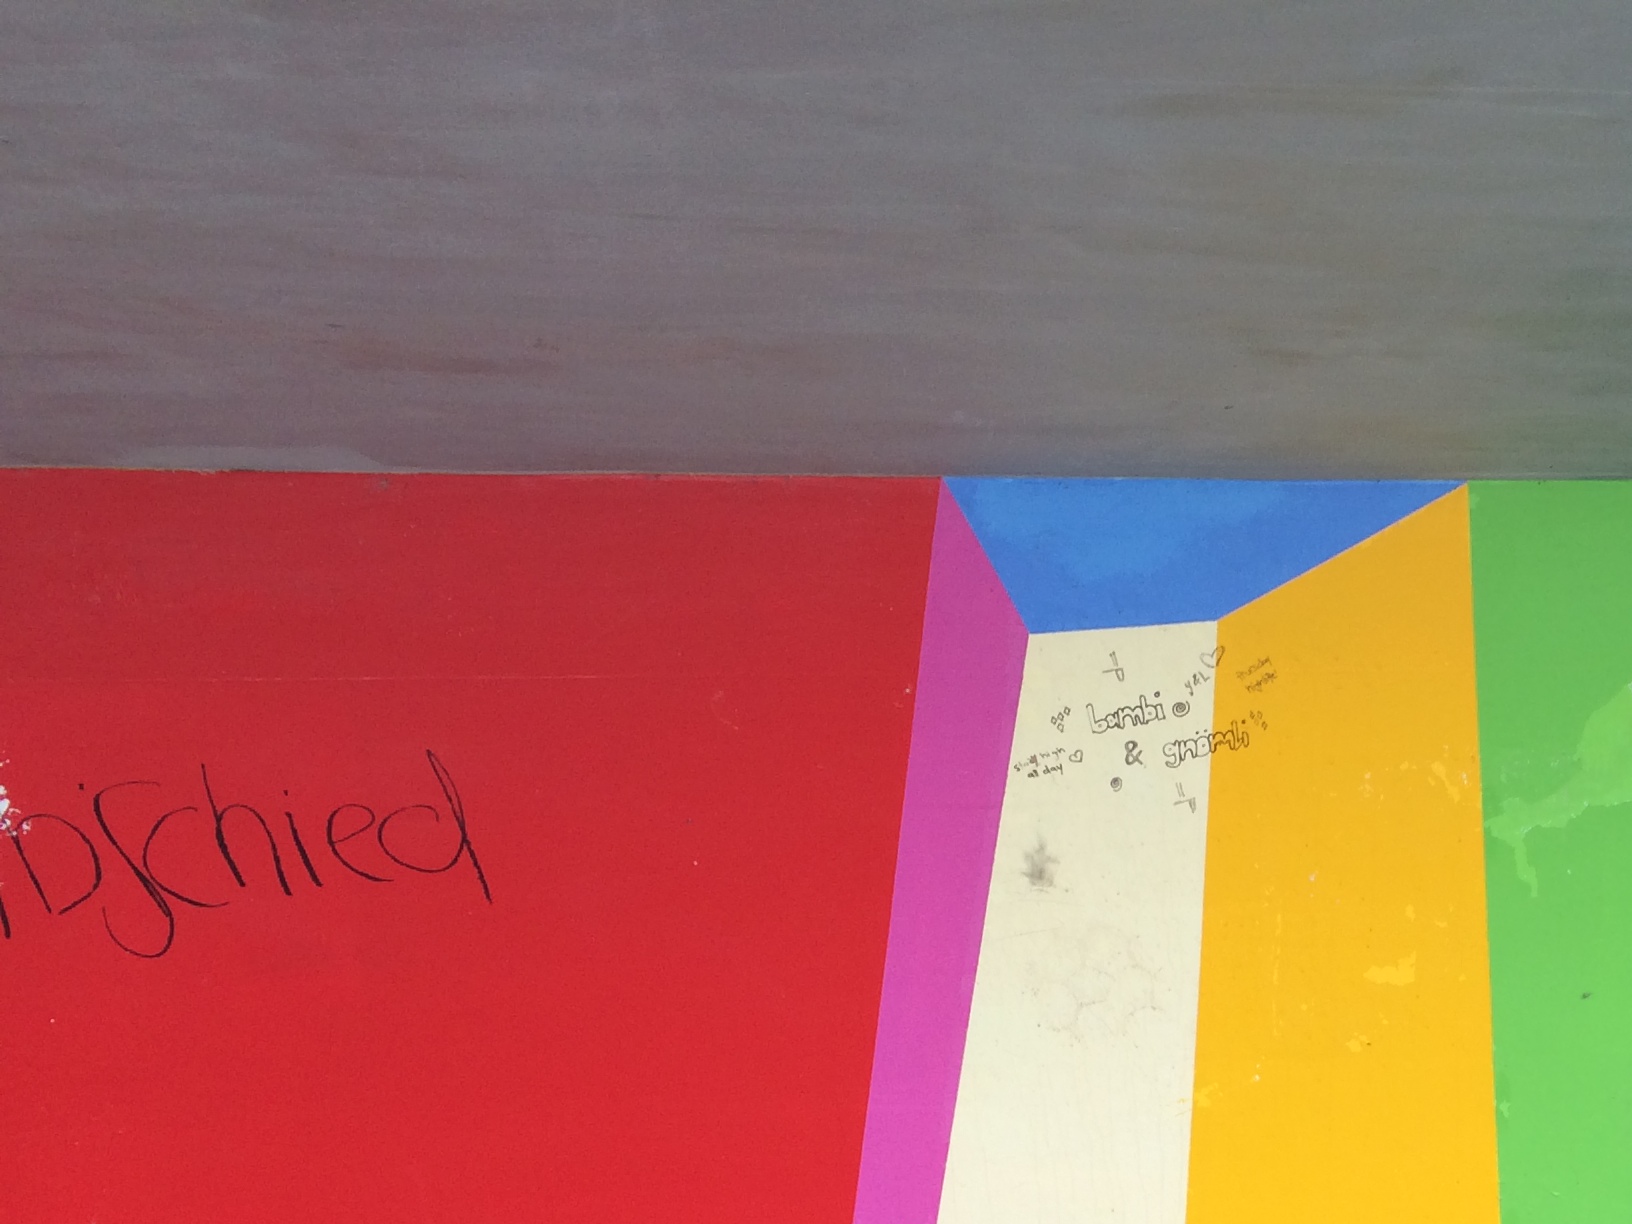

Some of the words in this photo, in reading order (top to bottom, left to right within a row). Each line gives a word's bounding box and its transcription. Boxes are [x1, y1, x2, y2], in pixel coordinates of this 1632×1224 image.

[1086, 691, 1166, 734] bambi
[1124, 740, 1143, 766] &
[1042, 763, 1064, 776] day
